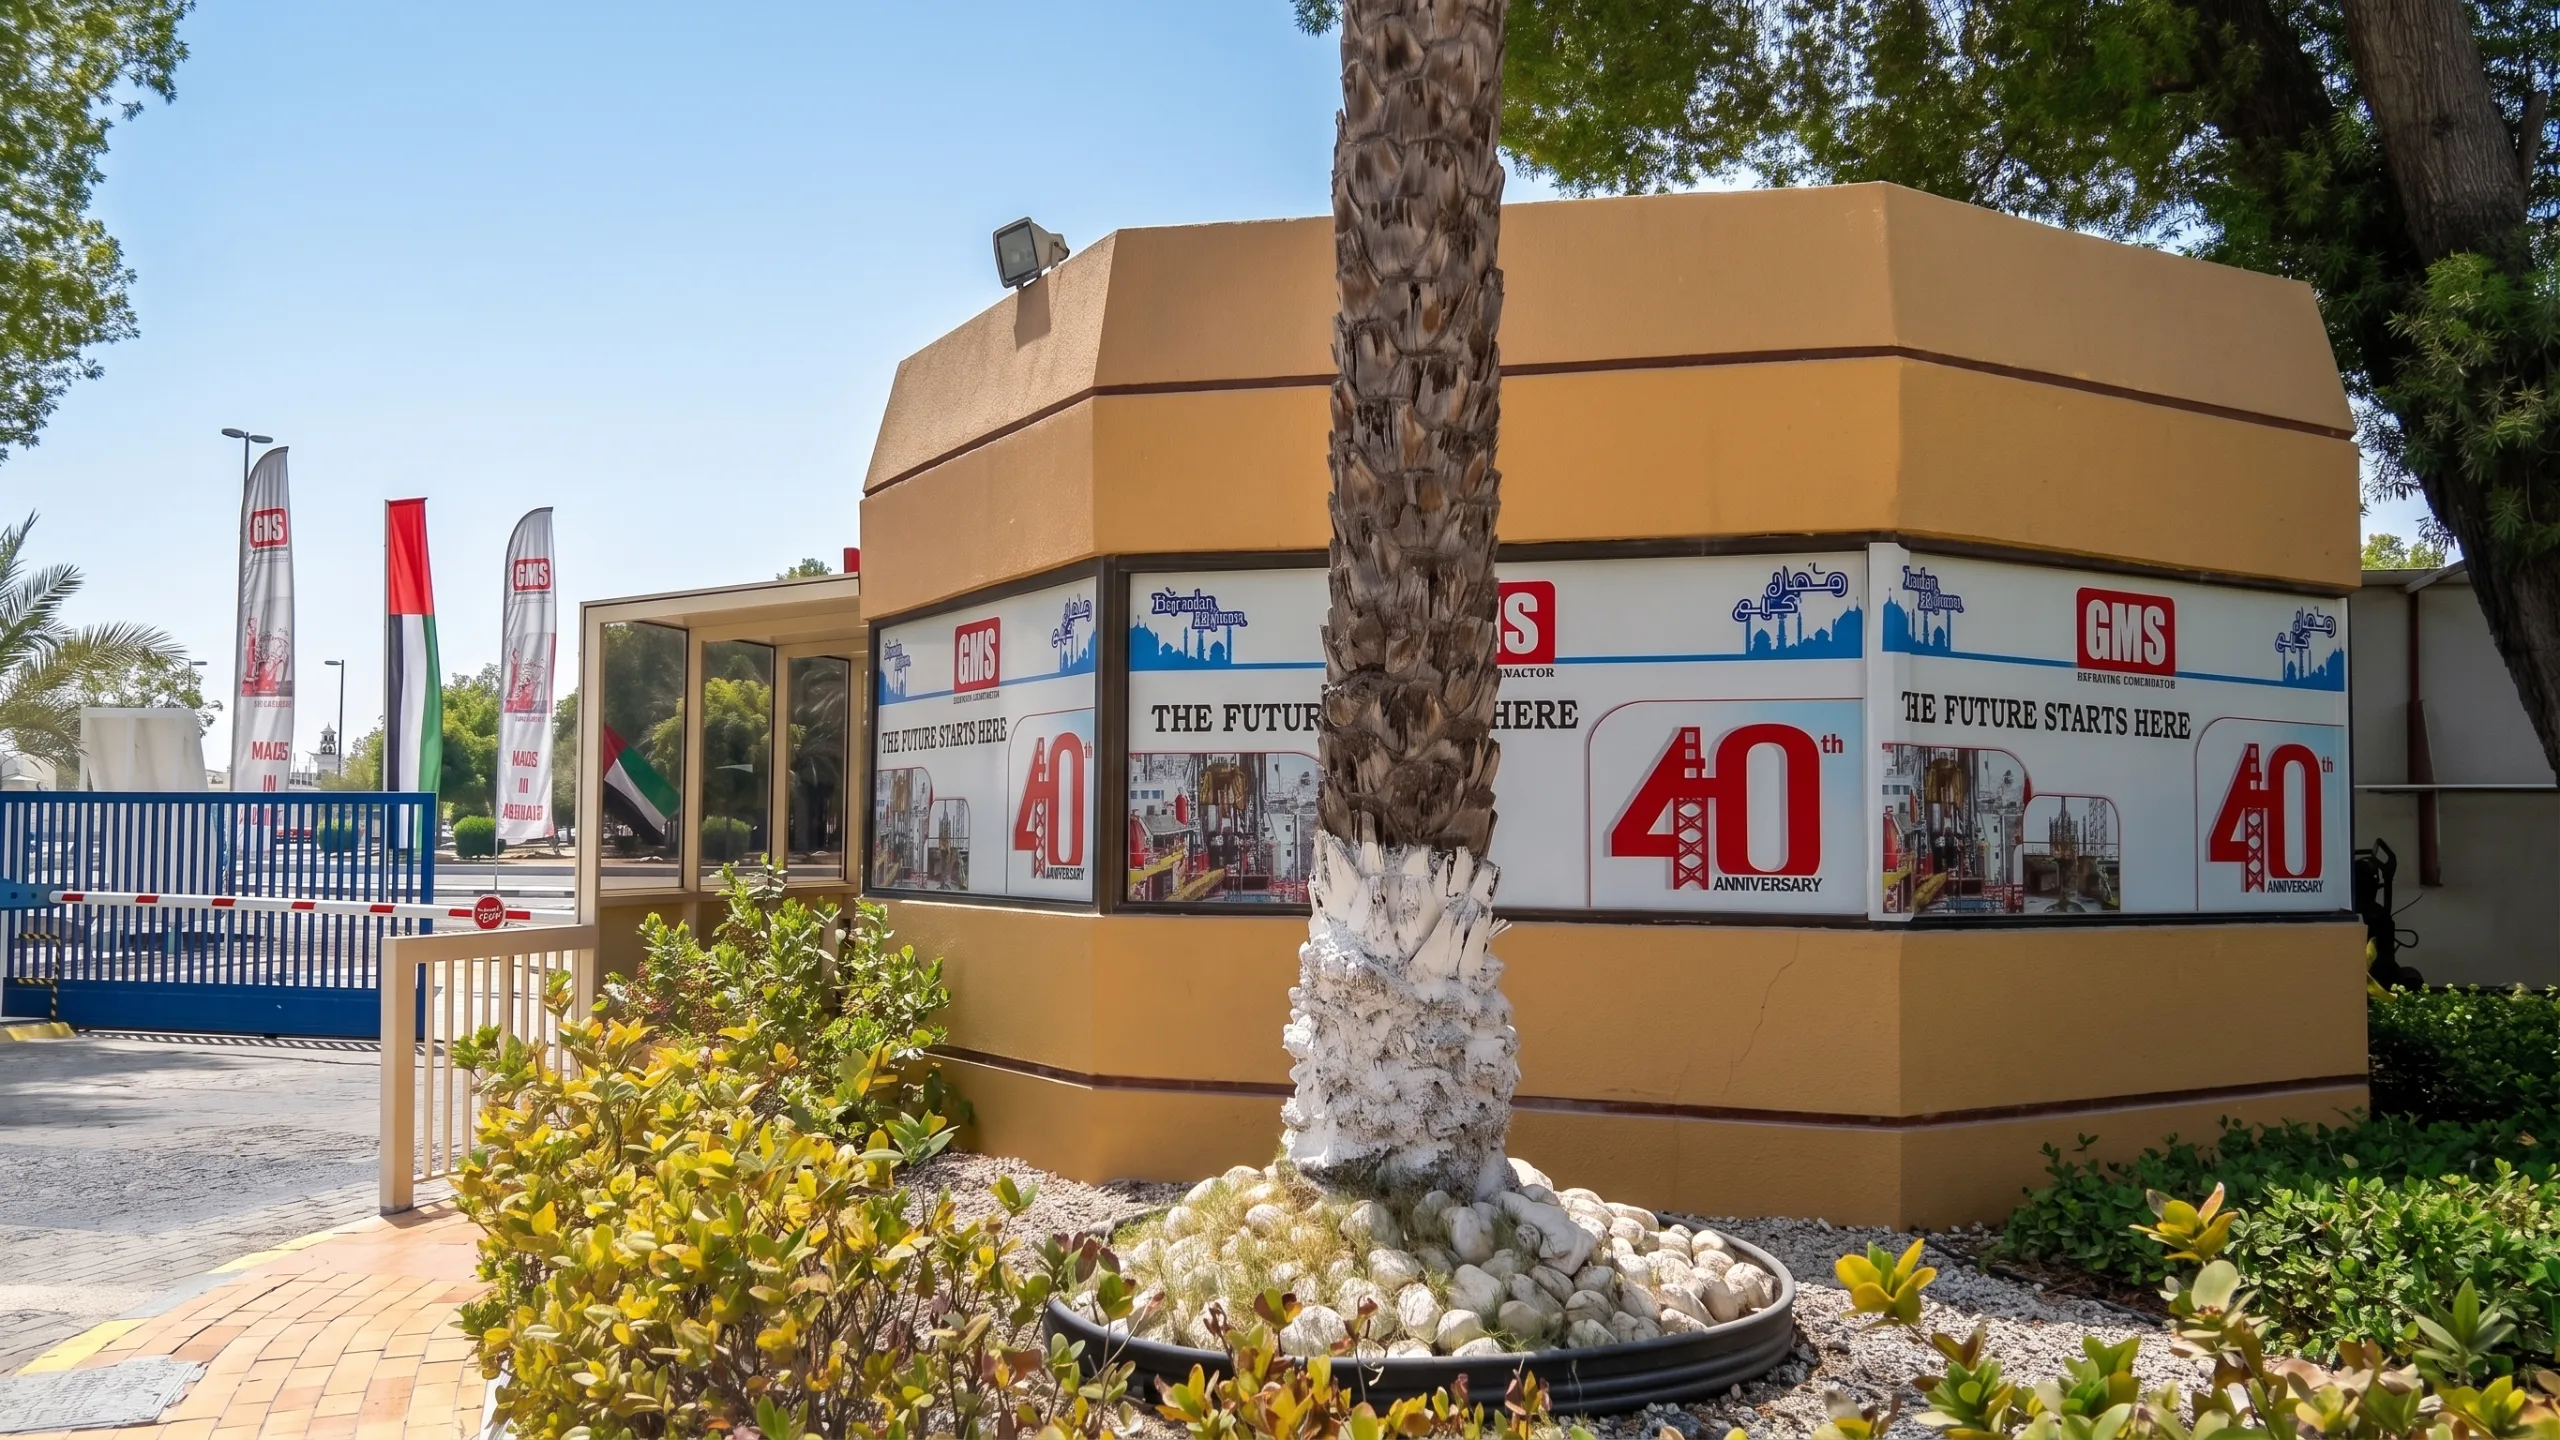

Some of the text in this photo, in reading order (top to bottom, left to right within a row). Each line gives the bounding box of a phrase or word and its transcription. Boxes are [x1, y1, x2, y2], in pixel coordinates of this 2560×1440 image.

[515, 562, 549, 587] GMS
[2086, 599, 2166, 666] GMS
[958, 628, 996, 685] GMS
[1151, 700, 1579, 732] THE FUTUR HERE
[1901, 691, 2191, 739] THE FUTURE STARTS HERE
[882, 731, 899, 754] THE
[939, 721, 975, 748] STARTS
[1713, 877, 1823, 892] ANNIVERSARY
[2267, 880, 2324, 893] ANNIVERSARY
